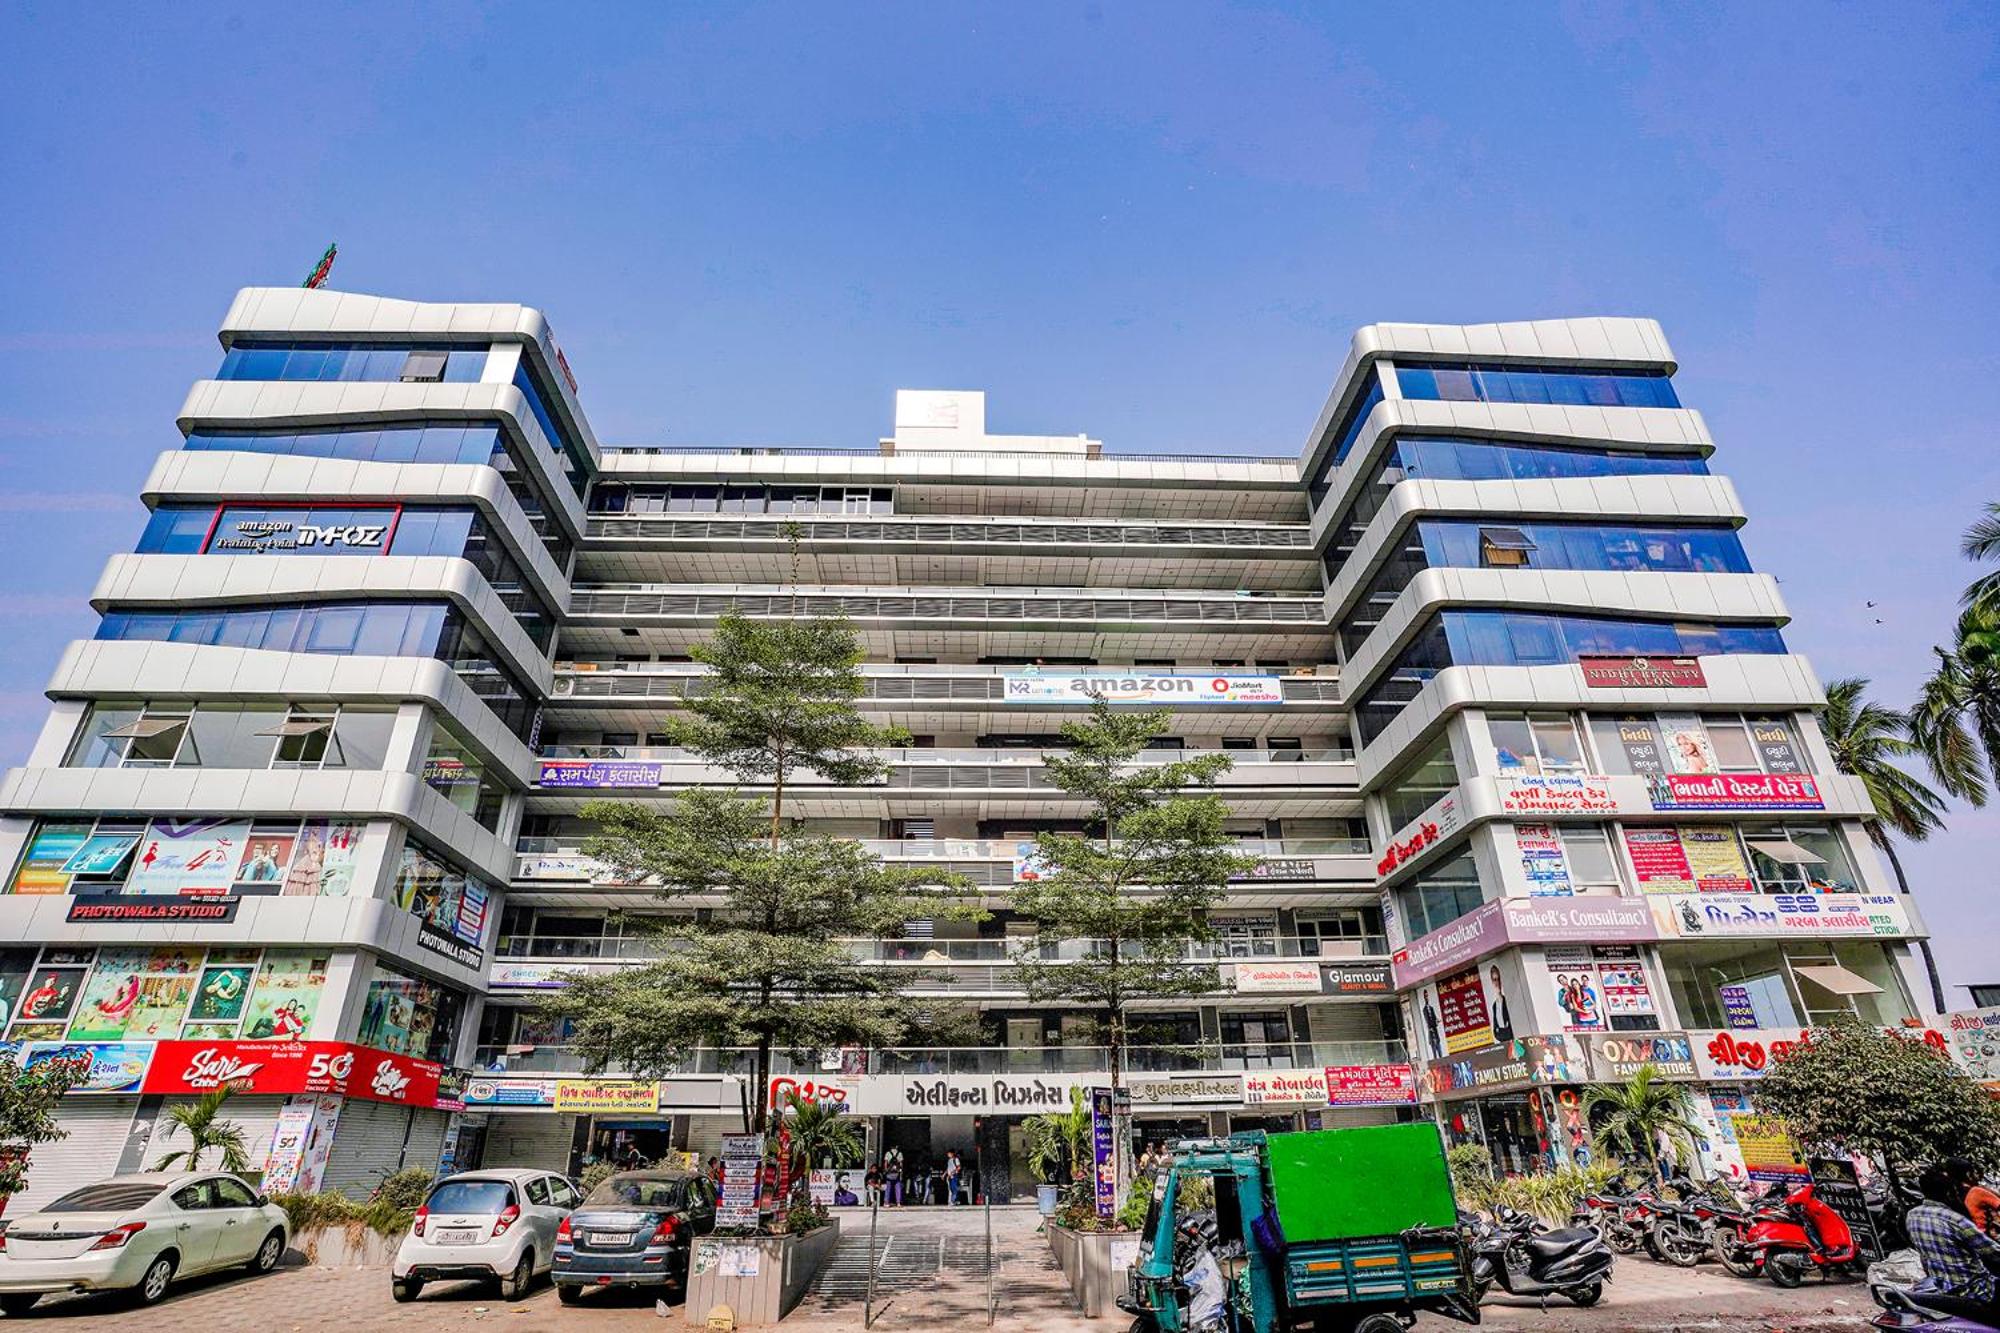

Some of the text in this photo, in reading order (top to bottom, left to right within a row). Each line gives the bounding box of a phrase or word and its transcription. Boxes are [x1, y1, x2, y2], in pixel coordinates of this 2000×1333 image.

[236, 520, 293, 534] amazon
[1641, 669, 1698, 679] BEAUTY
[1070, 678, 1194, 692] amazon
[1621, 677, 1673, 686] SALON
[1674, 778, 1726, 796] ભવાની
[1775, 778, 1799, 796] વેર
[167, 905, 227, 917] STUDIO
[1329, 970, 1385, 982] Glamour
[1603, 1039, 1691, 1062] OXXON
[1708, 1033, 1766, 1070] શ્રીજી
[1474, 1067, 1501, 1085] FAMILY
[1502, 1062, 1529, 1080] STORE
[1657, 1063, 1694, 1074] STORE
[906, 1080, 988, 1107] એલીફન્ટા
